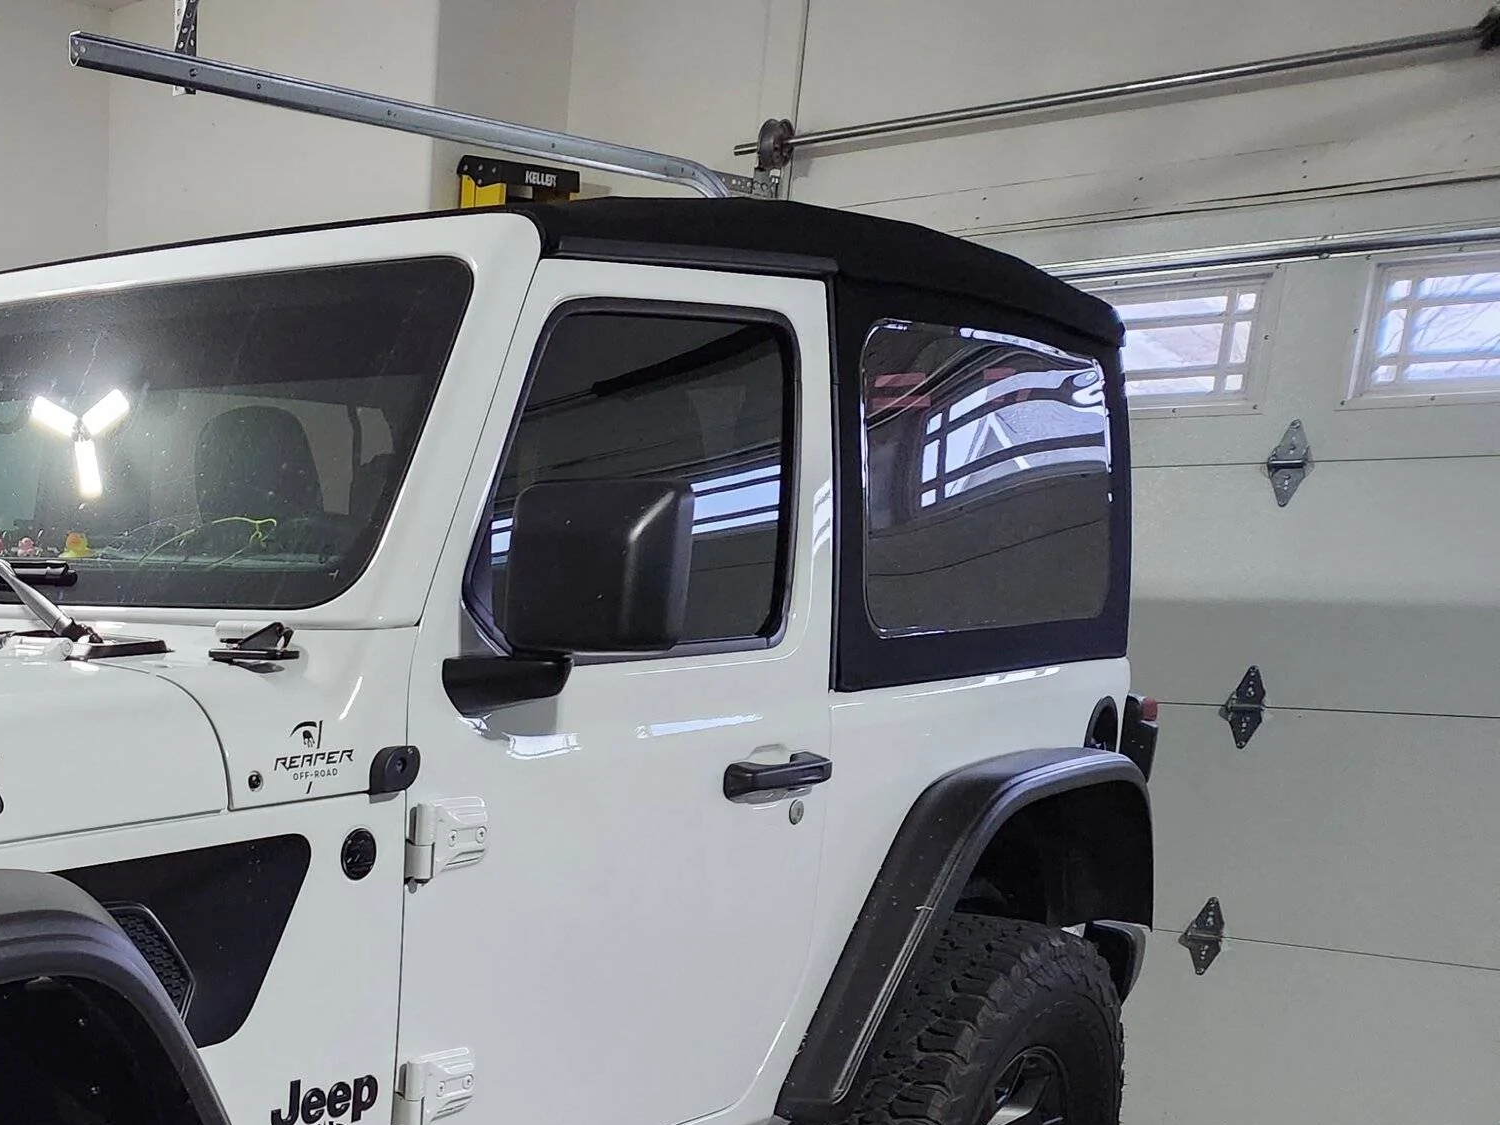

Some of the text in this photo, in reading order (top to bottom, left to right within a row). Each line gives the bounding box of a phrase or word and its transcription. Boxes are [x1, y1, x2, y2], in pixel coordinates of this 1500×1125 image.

[524, 169, 557, 188] KELLER
[274, 748, 355, 772] REAPER
[293, 768, 338, 781] OFF-ROAD
